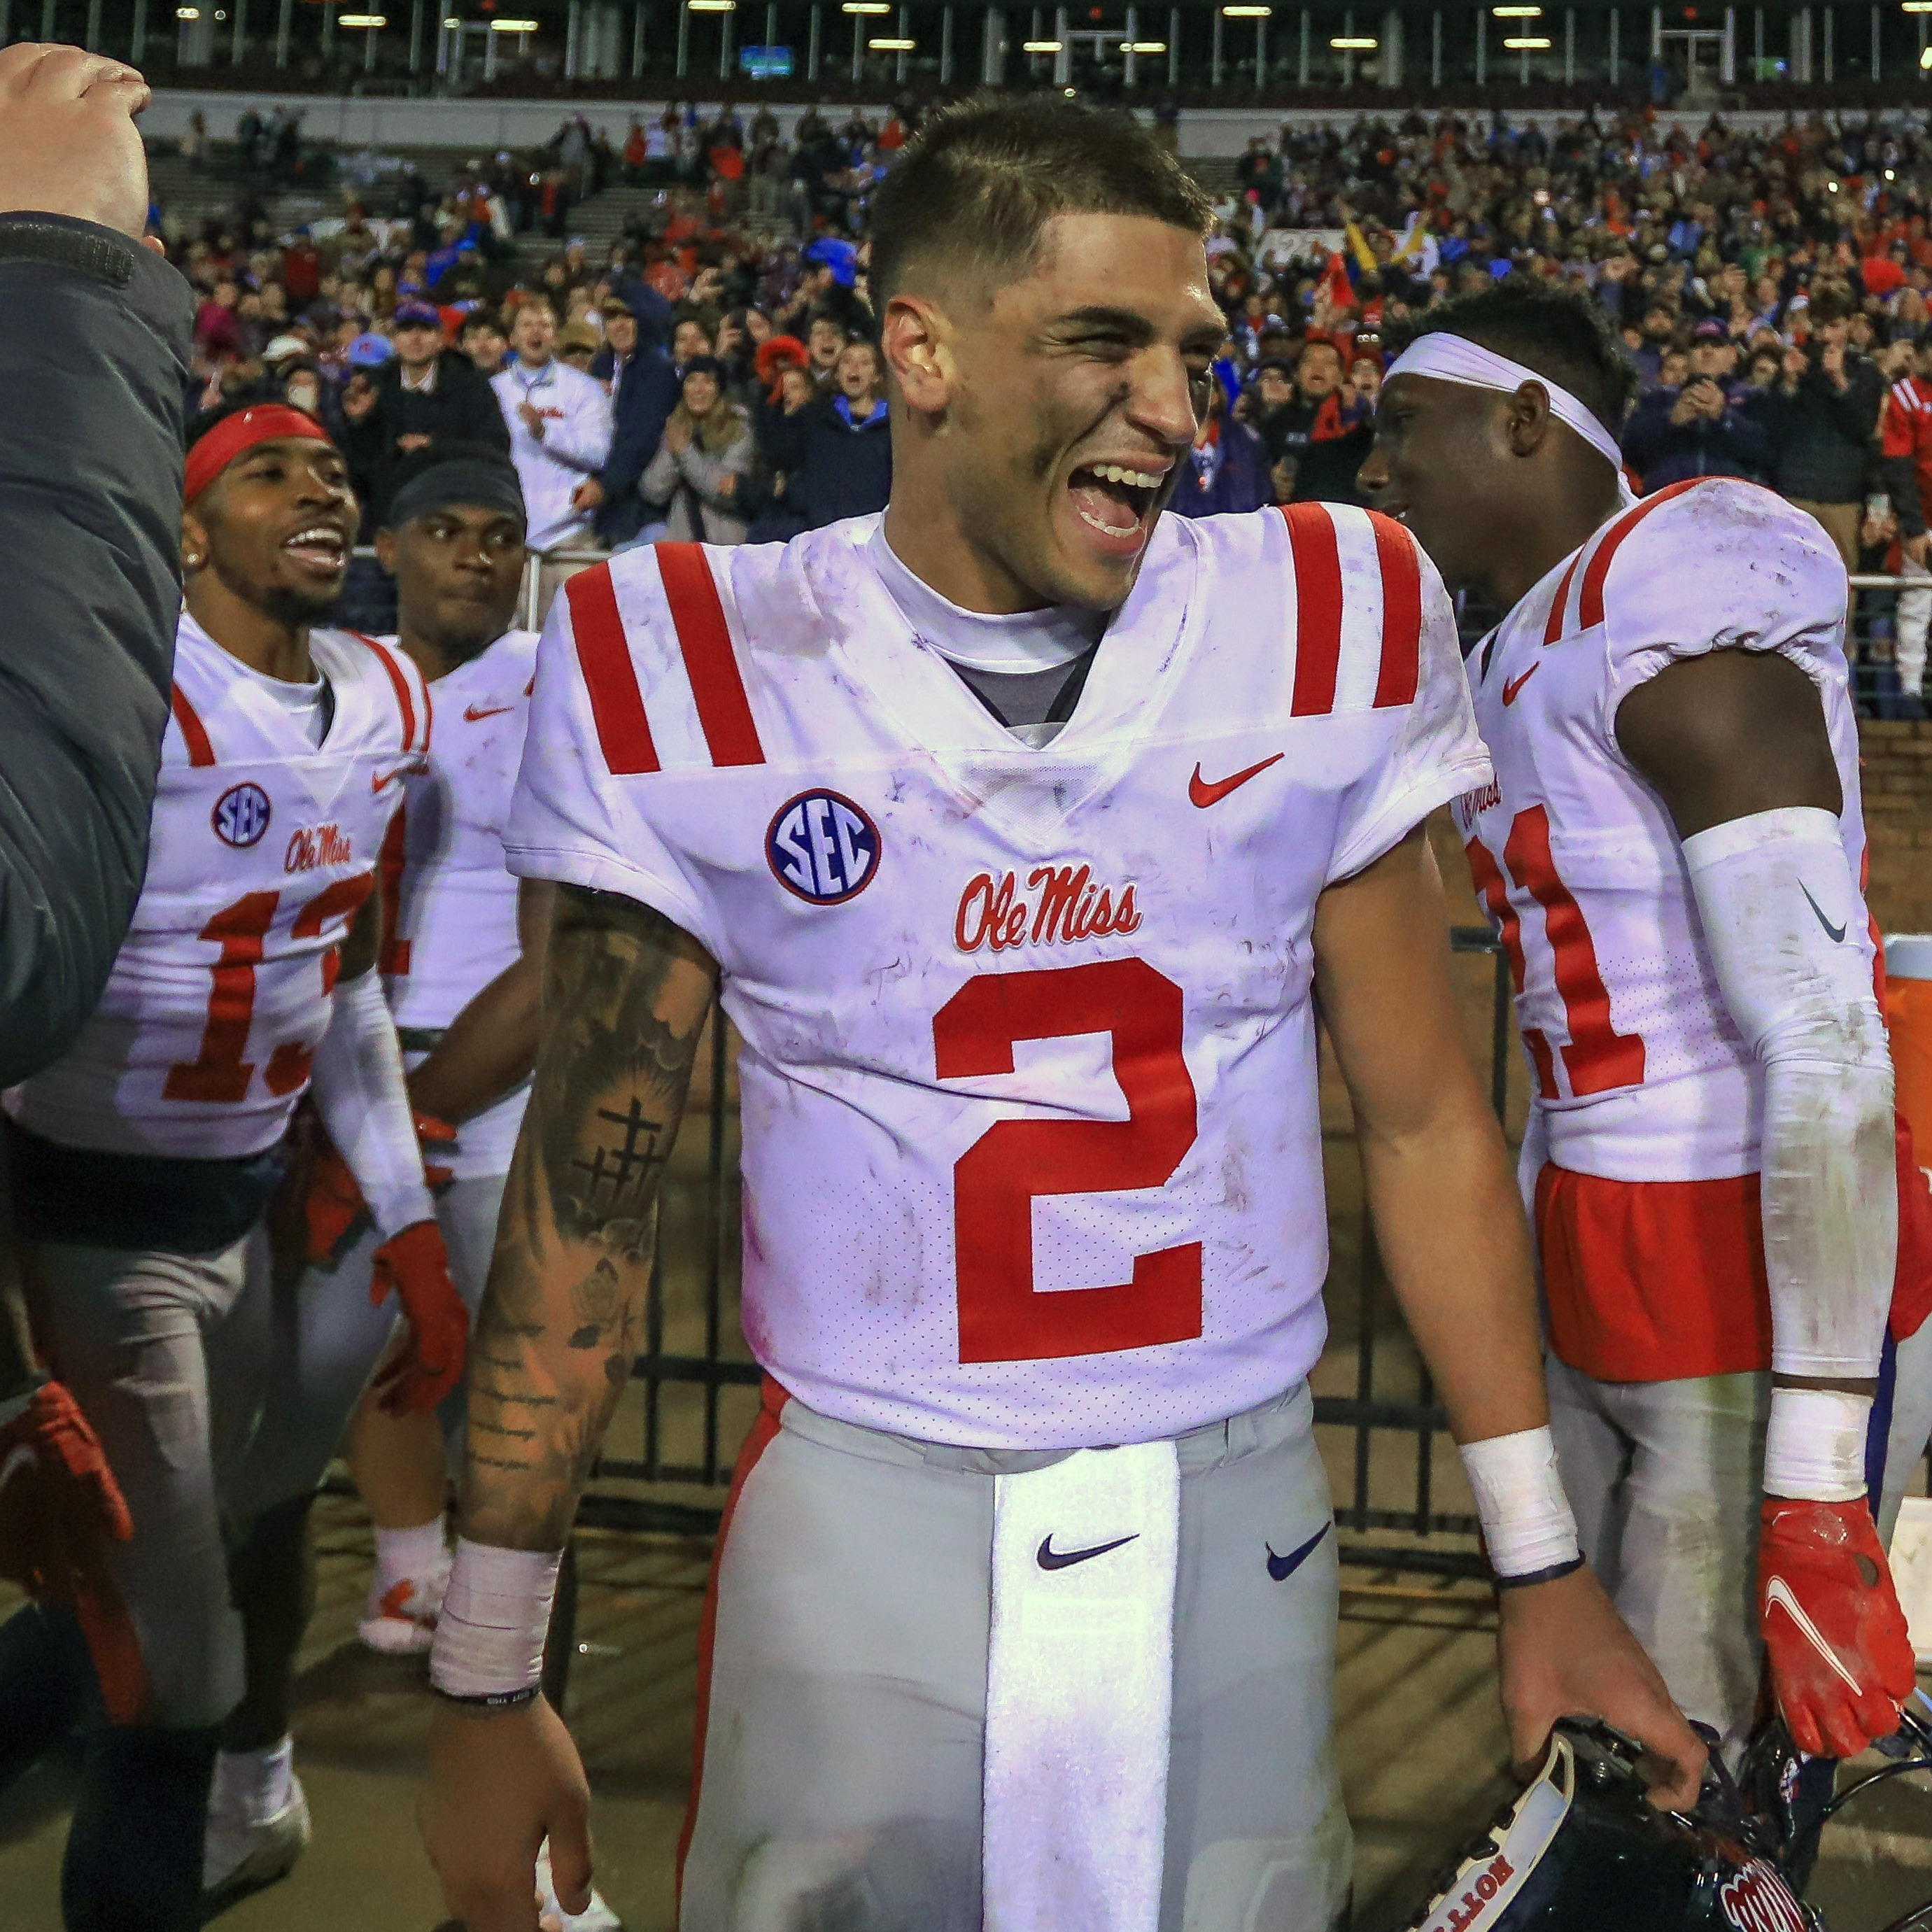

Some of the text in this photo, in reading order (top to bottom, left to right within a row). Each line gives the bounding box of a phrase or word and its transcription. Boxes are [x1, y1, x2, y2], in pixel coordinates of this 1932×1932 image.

[218, 787, 267, 843] SEC
[284, 823, 351, 873] Ole Miss
[775, 798, 871, 895] SEC
[953, 863, 1143, 952] Ole Miss
[933, 957, 1203, 1365] 2
[1432, 1854, 1515, 1932] HOTT
